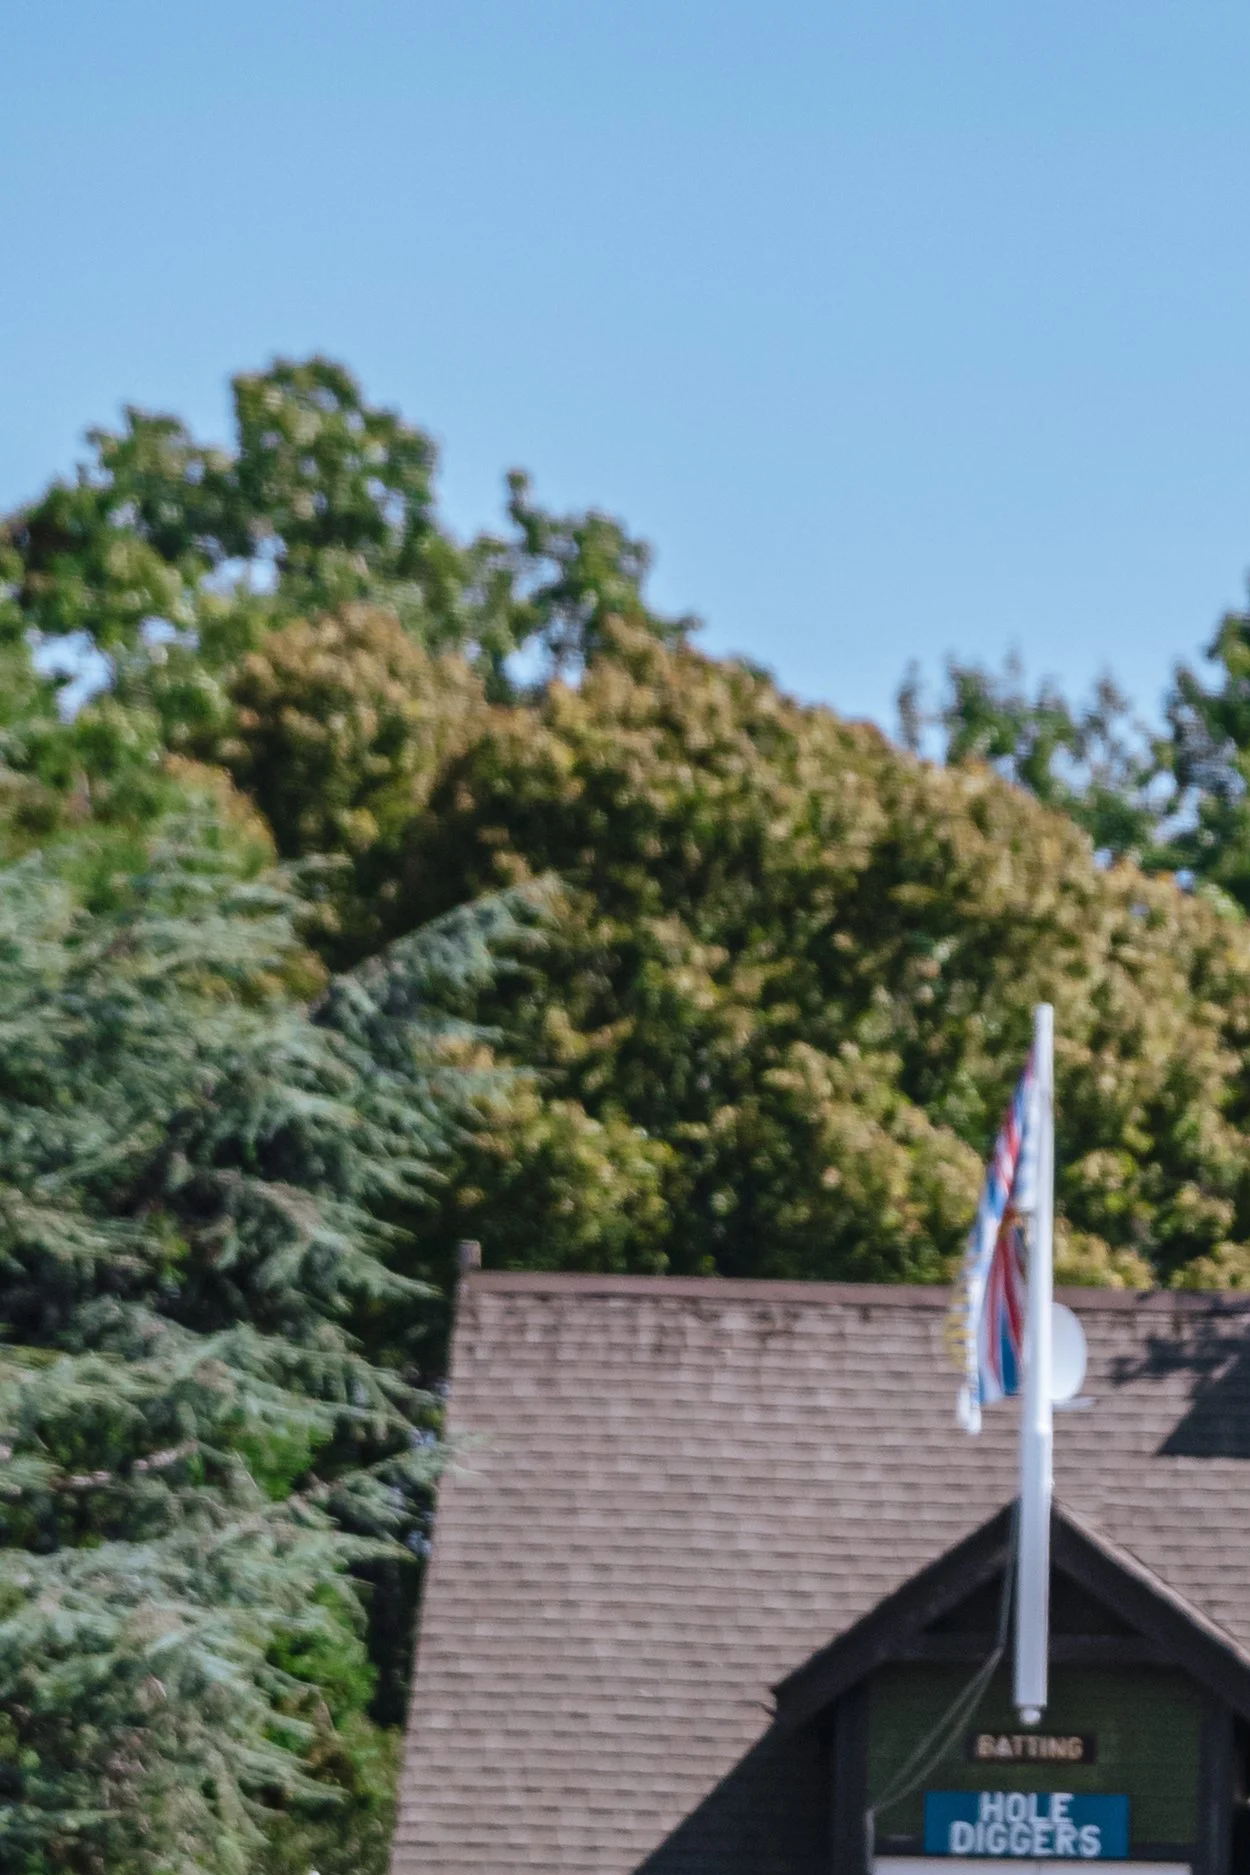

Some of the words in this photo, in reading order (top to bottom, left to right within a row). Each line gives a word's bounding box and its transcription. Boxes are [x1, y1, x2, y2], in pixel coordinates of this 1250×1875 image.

[976, 1734, 1084, 1760] BATTING
[978, 1791, 1074, 1824] HOLE
[949, 1820, 1102, 1858] DIGGERS
